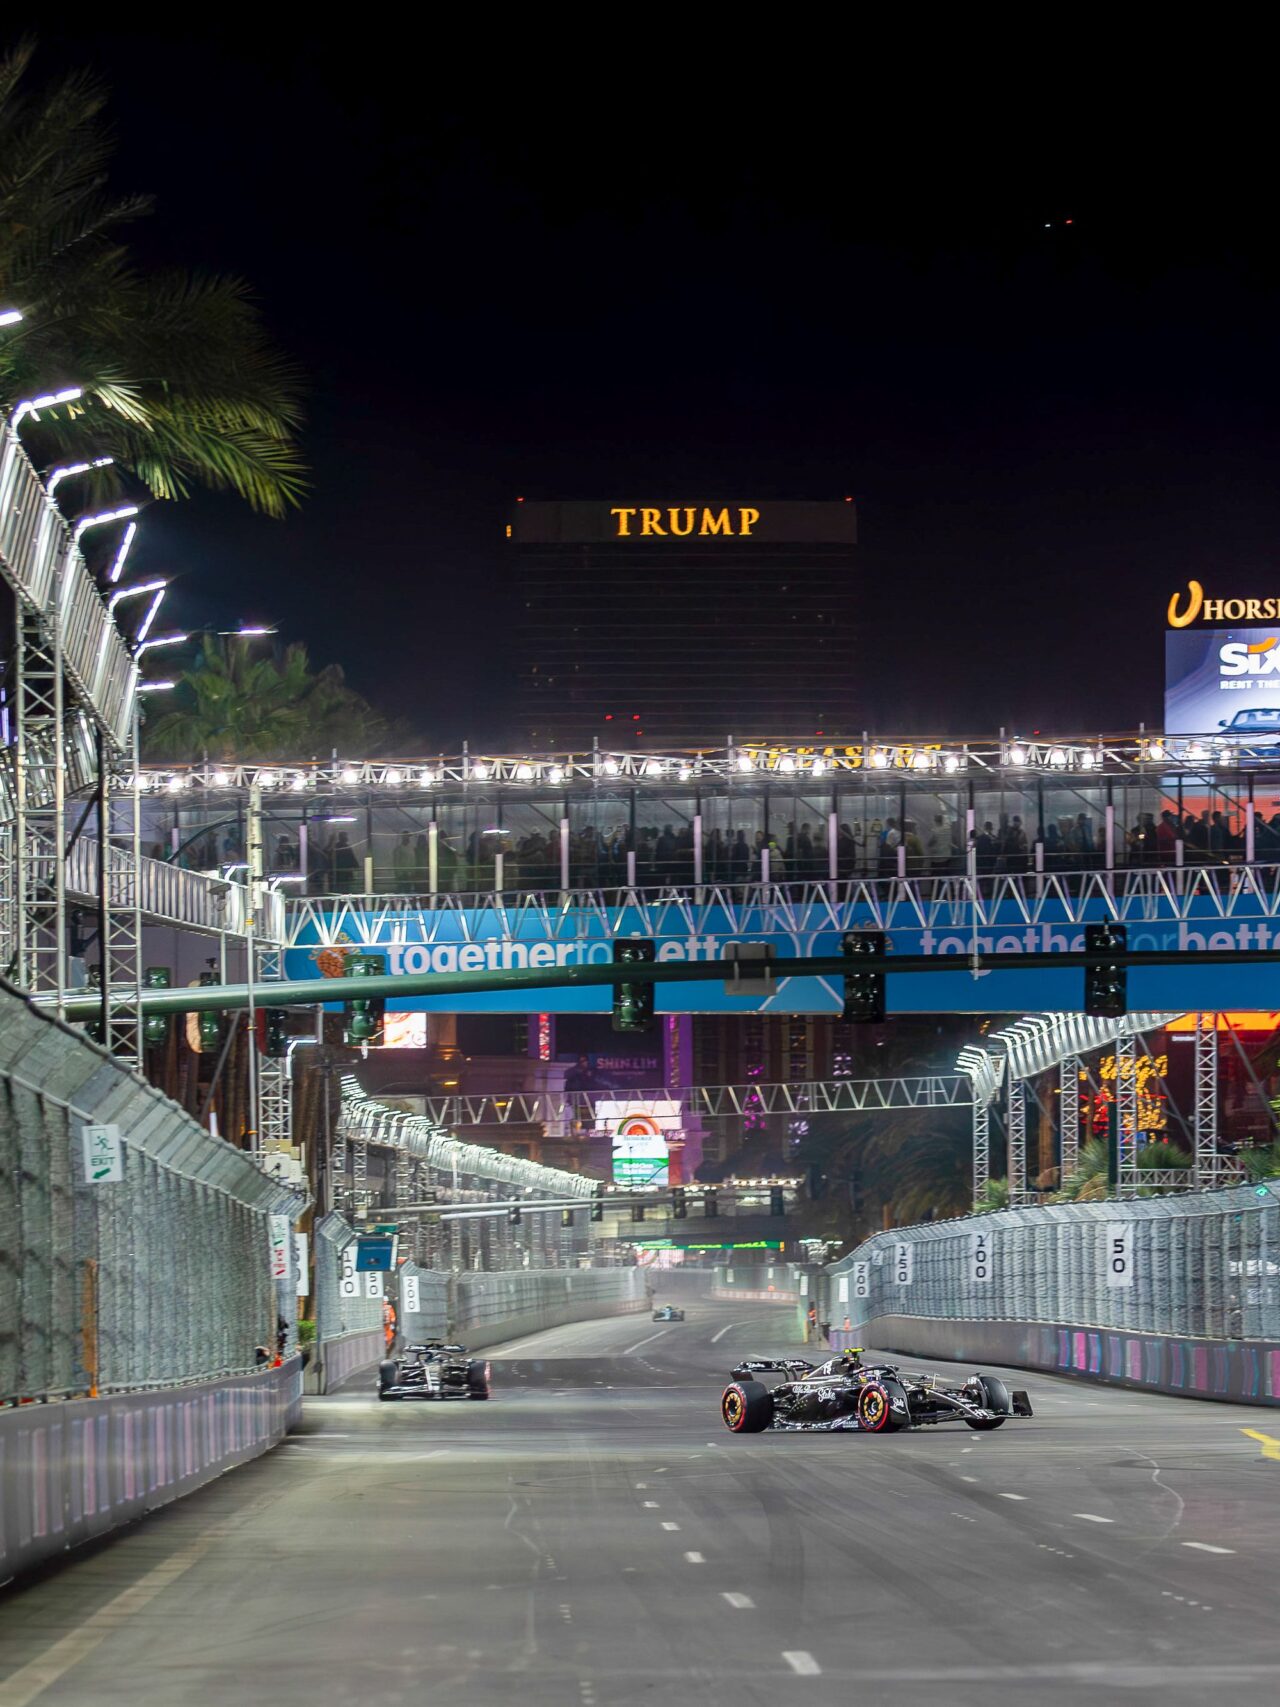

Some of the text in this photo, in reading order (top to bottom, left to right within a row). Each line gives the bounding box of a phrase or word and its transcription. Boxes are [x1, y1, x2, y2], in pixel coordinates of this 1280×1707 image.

[611, 508, 759, 536] TRUMP
[1220, 681, 1253, 689] RENT
[1257, 680, 1280, 688] THE
[920, 924, 1086, 976] togethe
[343, 1251, 354, 1293] 100
[899, 1245, 908, 1282] 150
[976, 1235, 987, 1278] 100
[1113, 1238, 1125, 1273] 50
[407, 1279, 416, 1310] 200
[856, 1264, 866, 1296] 200
